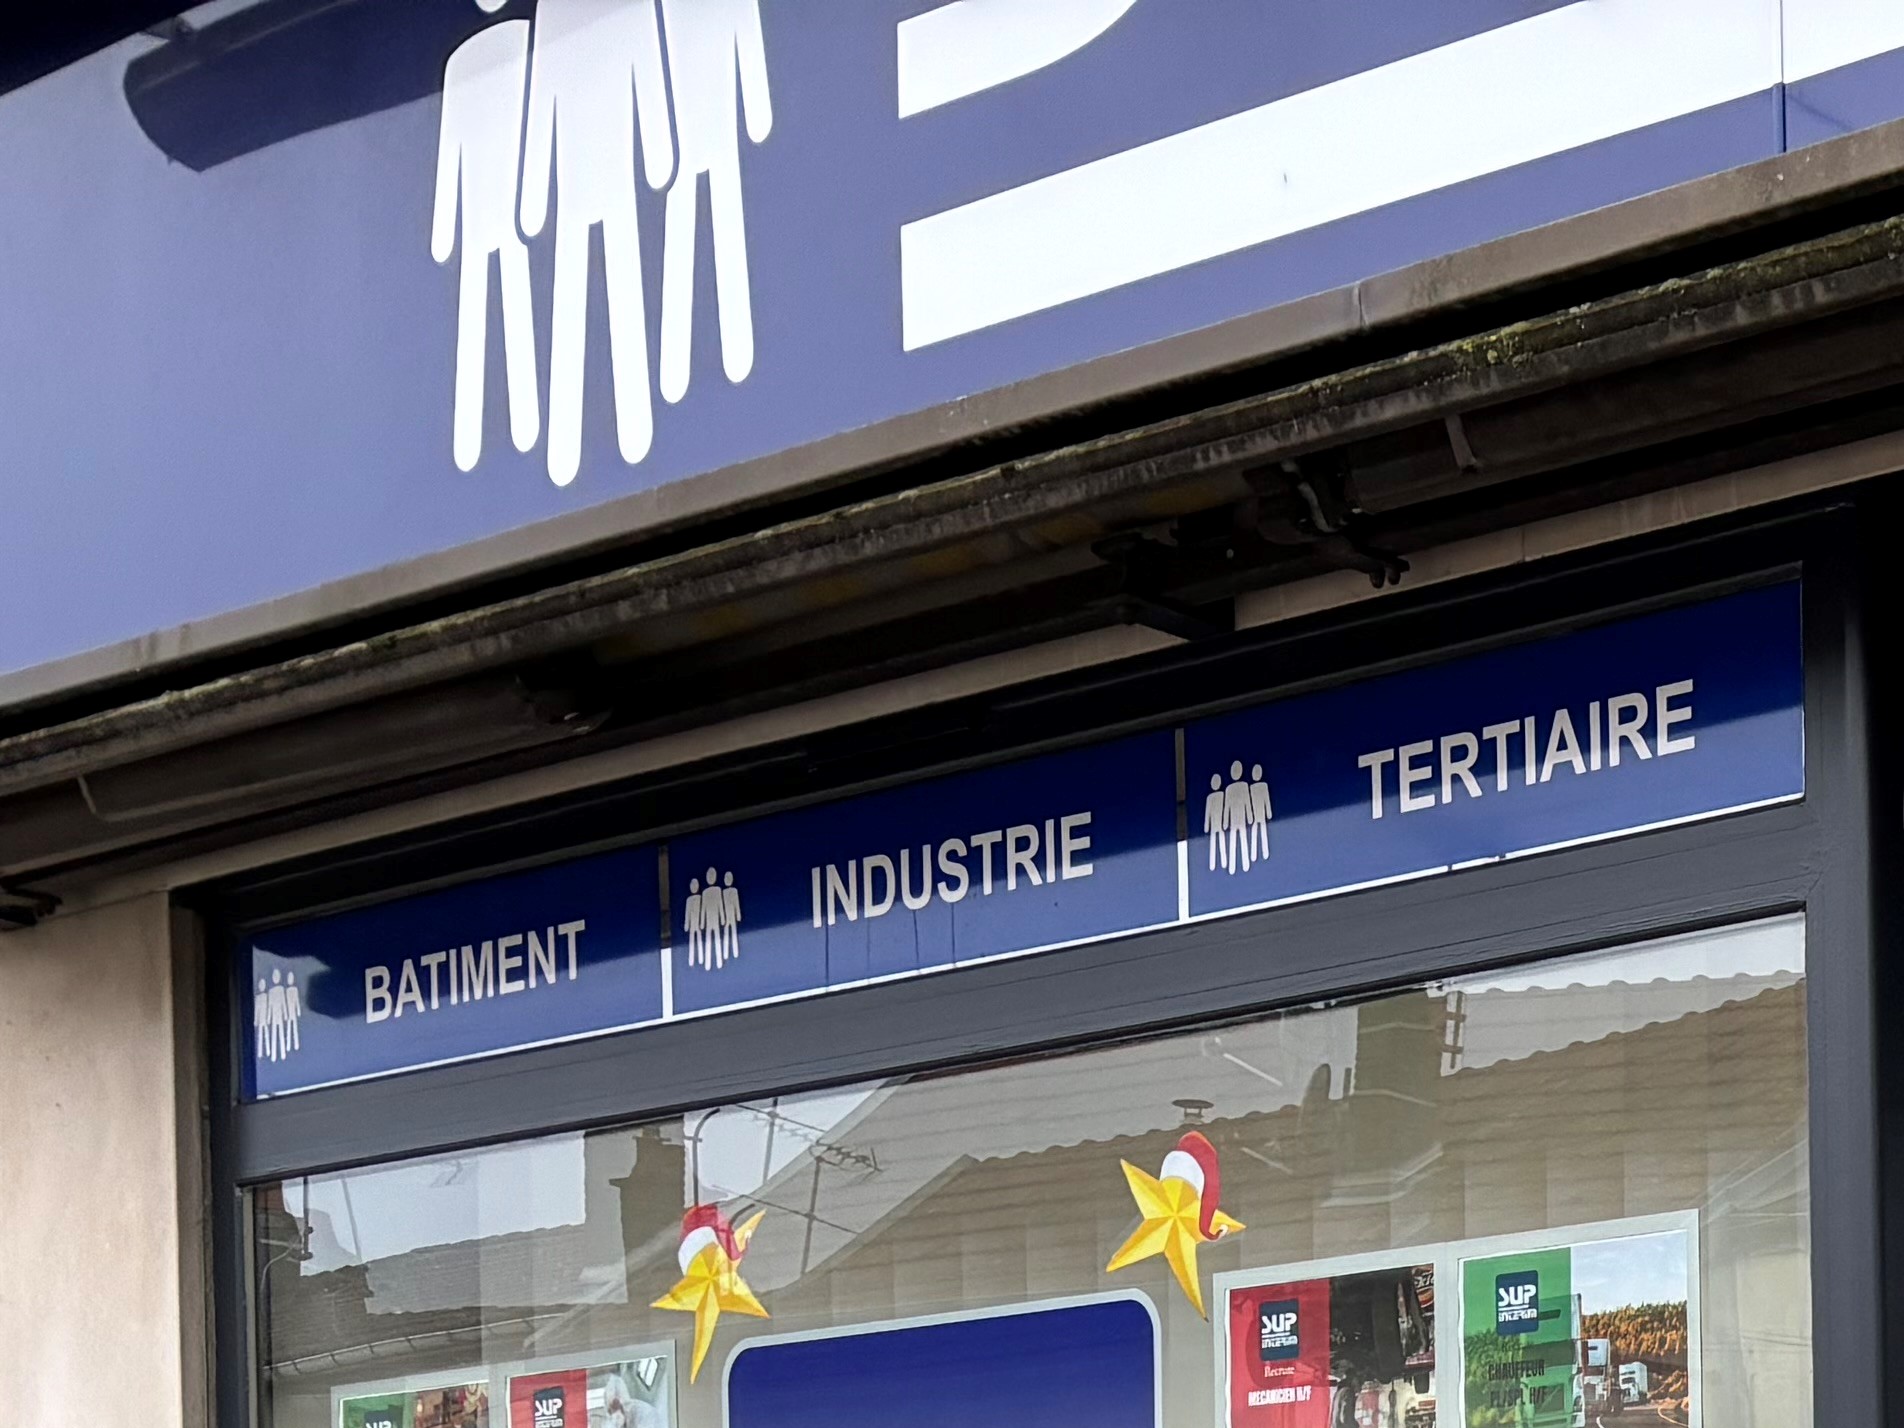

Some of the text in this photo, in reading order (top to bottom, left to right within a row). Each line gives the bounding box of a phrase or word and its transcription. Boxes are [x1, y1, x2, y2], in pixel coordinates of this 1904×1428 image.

[1356, 678, 1696, 822] TERTIAIRE
[810, 811, 1094, 930] INDUSTRIE
[364, 918, 587, 1025] BATIMENT
[1261, 1312, 1298, 1334] SUP
[1498, 1284, 1537, 1307] SUP
